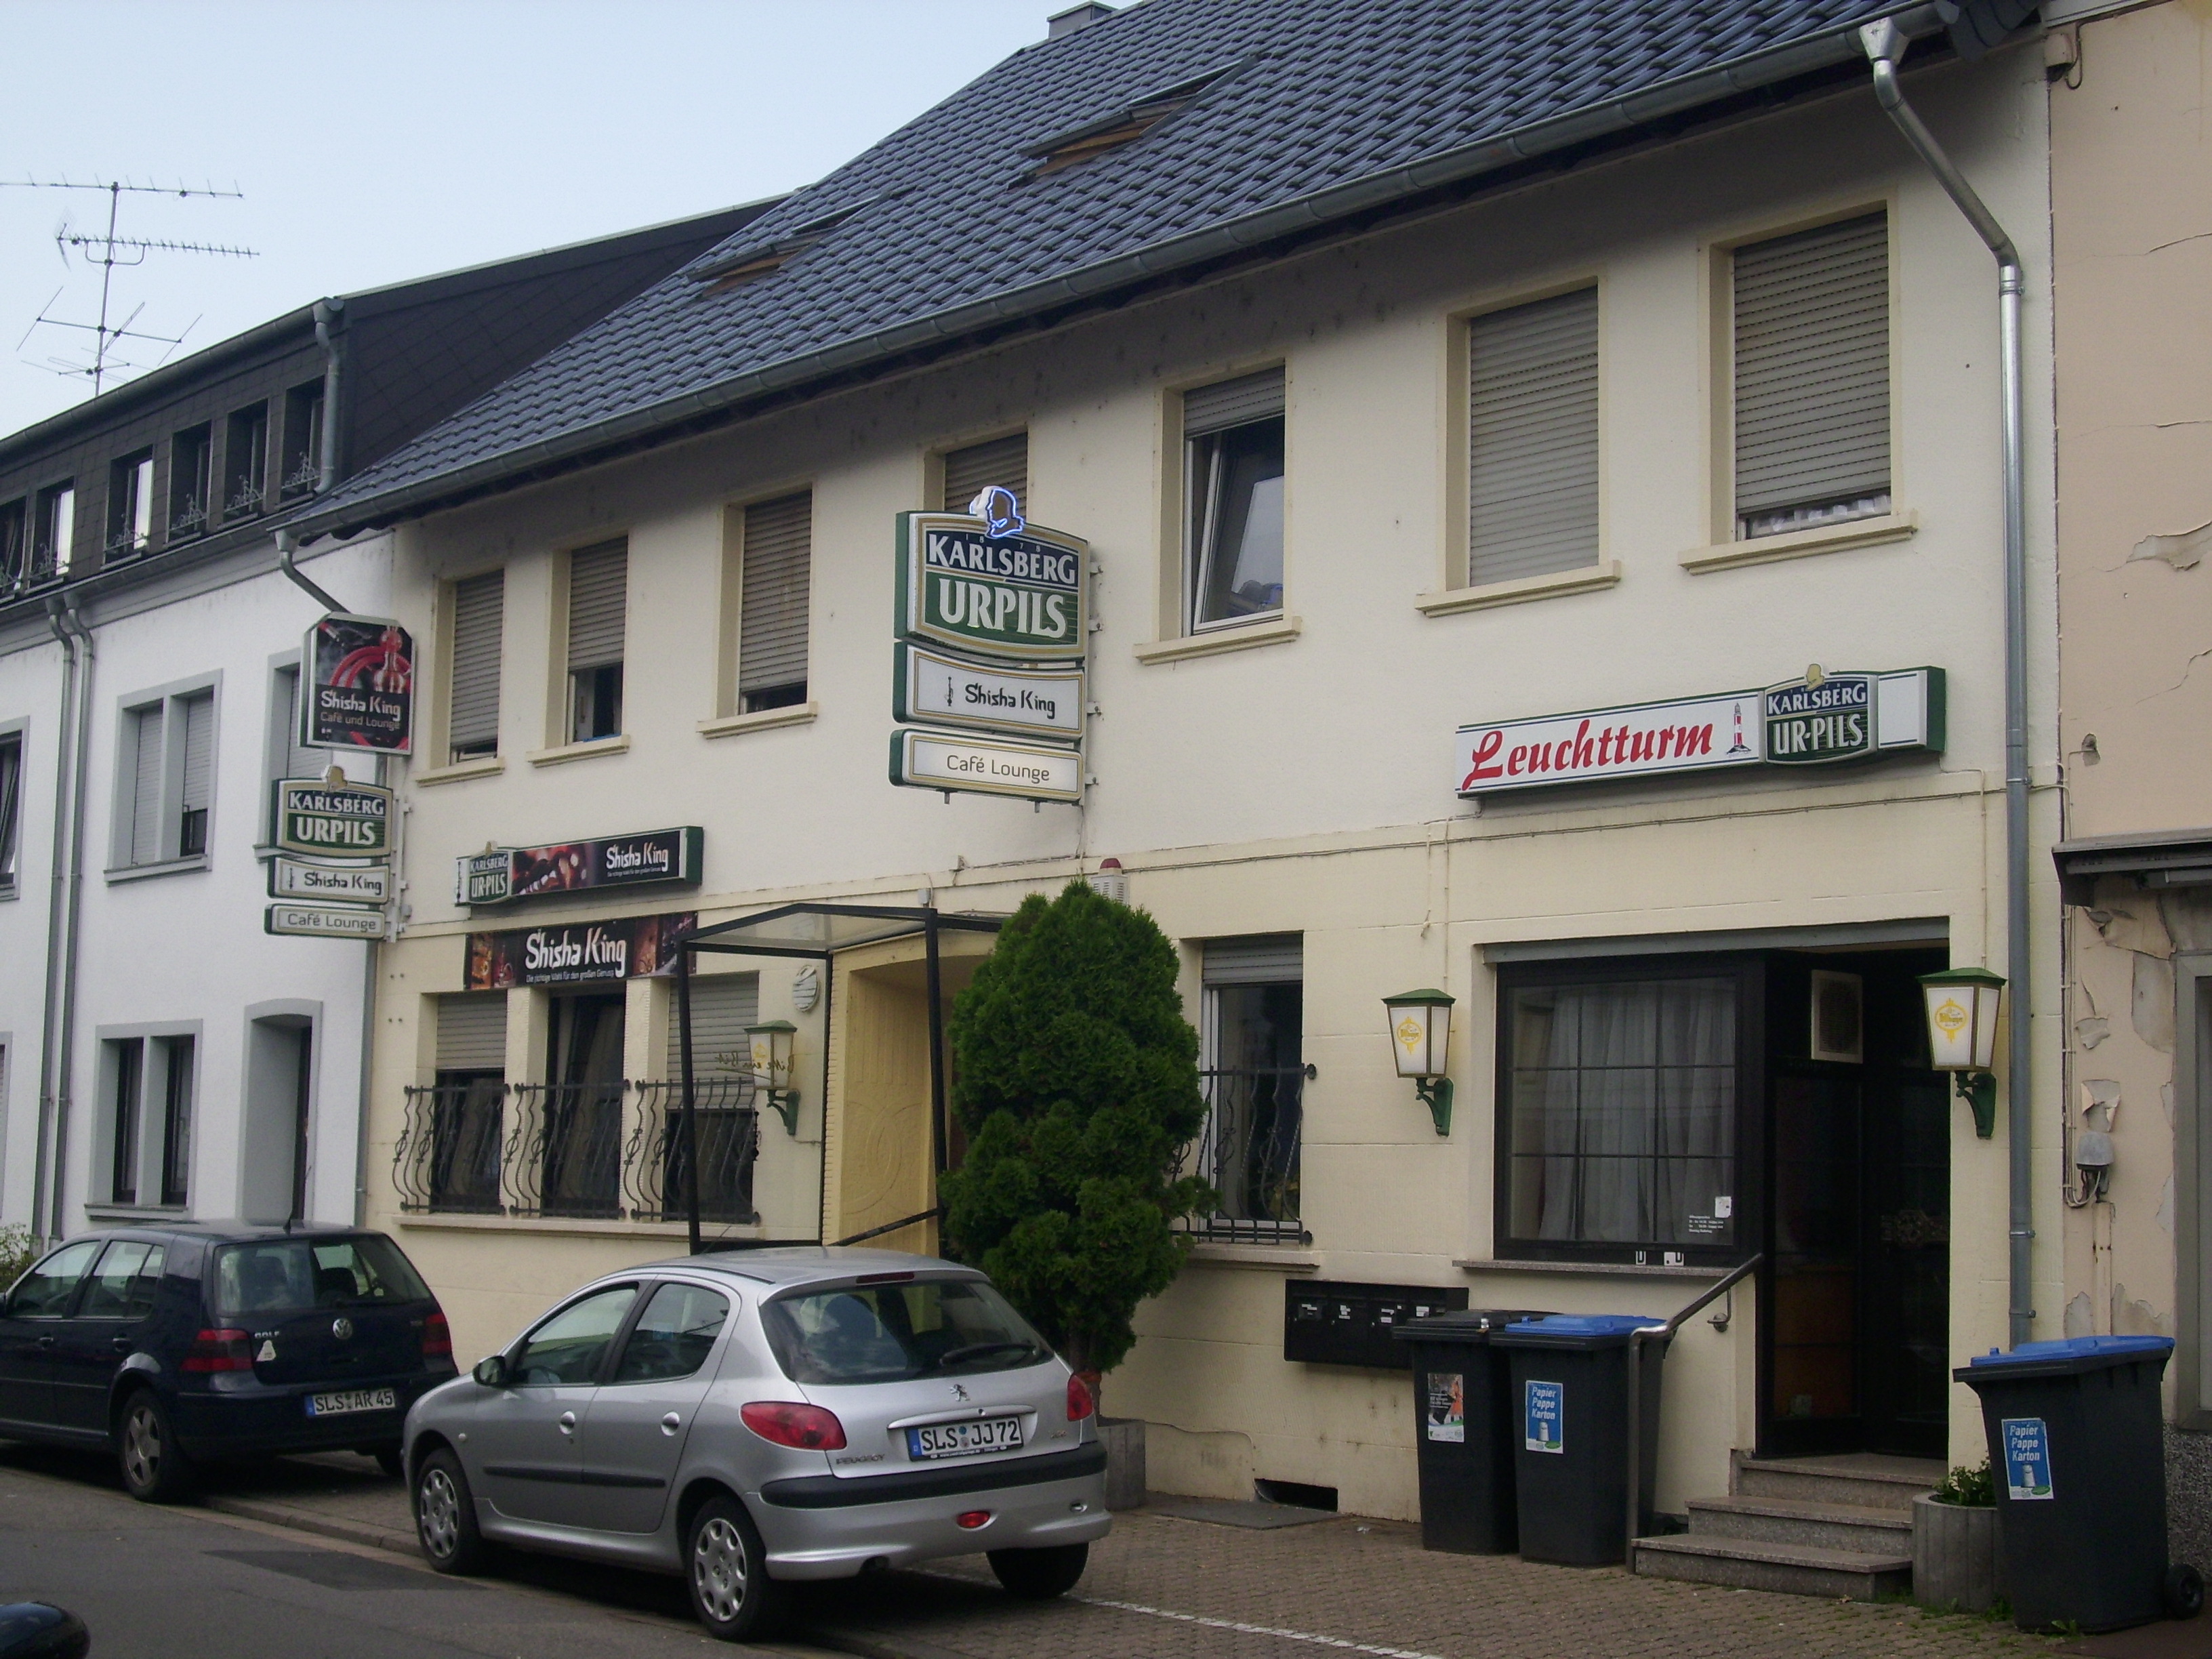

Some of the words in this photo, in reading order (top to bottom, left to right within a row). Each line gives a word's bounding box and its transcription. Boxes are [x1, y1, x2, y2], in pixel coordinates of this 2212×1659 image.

[928, 533, 1076, 584] KARLSBERG
[939, 578, 1066, 638] URPILS
[321, 690, 366, 712] Shisha
[369, 695, 401, 721] King
[965, 682, 1016, 708] Shisha
[1021, 689, 1055, 720] King
[1768, 683, 1866, 714] KARLSBERG
[345, 716, 363, 725] und
[366, 717, 400, 731] Lounge
[1774, 714, 1863, 754] UR-PILS
[1460, 719, 1713, 791] Leuchtturm
[947, 755, 985, 773] Café
[991, 760, 1050, 784] Lounge
[289, 792, 384, 815] KARLSBERG
[296, 817, 375, 845] URPILS
[470, 855, 508, 873] KARLSBERG
[607, 844, 640, 869] Shisha
[643, 842, 668, 872] King
[304, 872, 348, 888] Shisha
[352, 875, 382, 895] King
[472, 874, 506, 897] UR-PILS
[288, 914, 321, 926] Café
[326, 916, 376, 933] Lounge
[525, 928, 581, 969] Shisha
[584, 927, 626, 977] King
[315, 1395, 345, 1412] SLS
[355, 1391, 373, 1408] AR
[376, 1389, 393, 1406] 45
[1532, 1387, 1556, 1399] Papier
[1532, 1397, 1555, 1410] Pappe
[1532, 1408, 1555, 1420] Karton
[921, 1428, 958, 1451] SLS
[2009, 1425, 2039, 1438] Papier
[2011, 1437, 2038, 1450] Pappe
[2012, 1450, 2040, 1461] Karton
